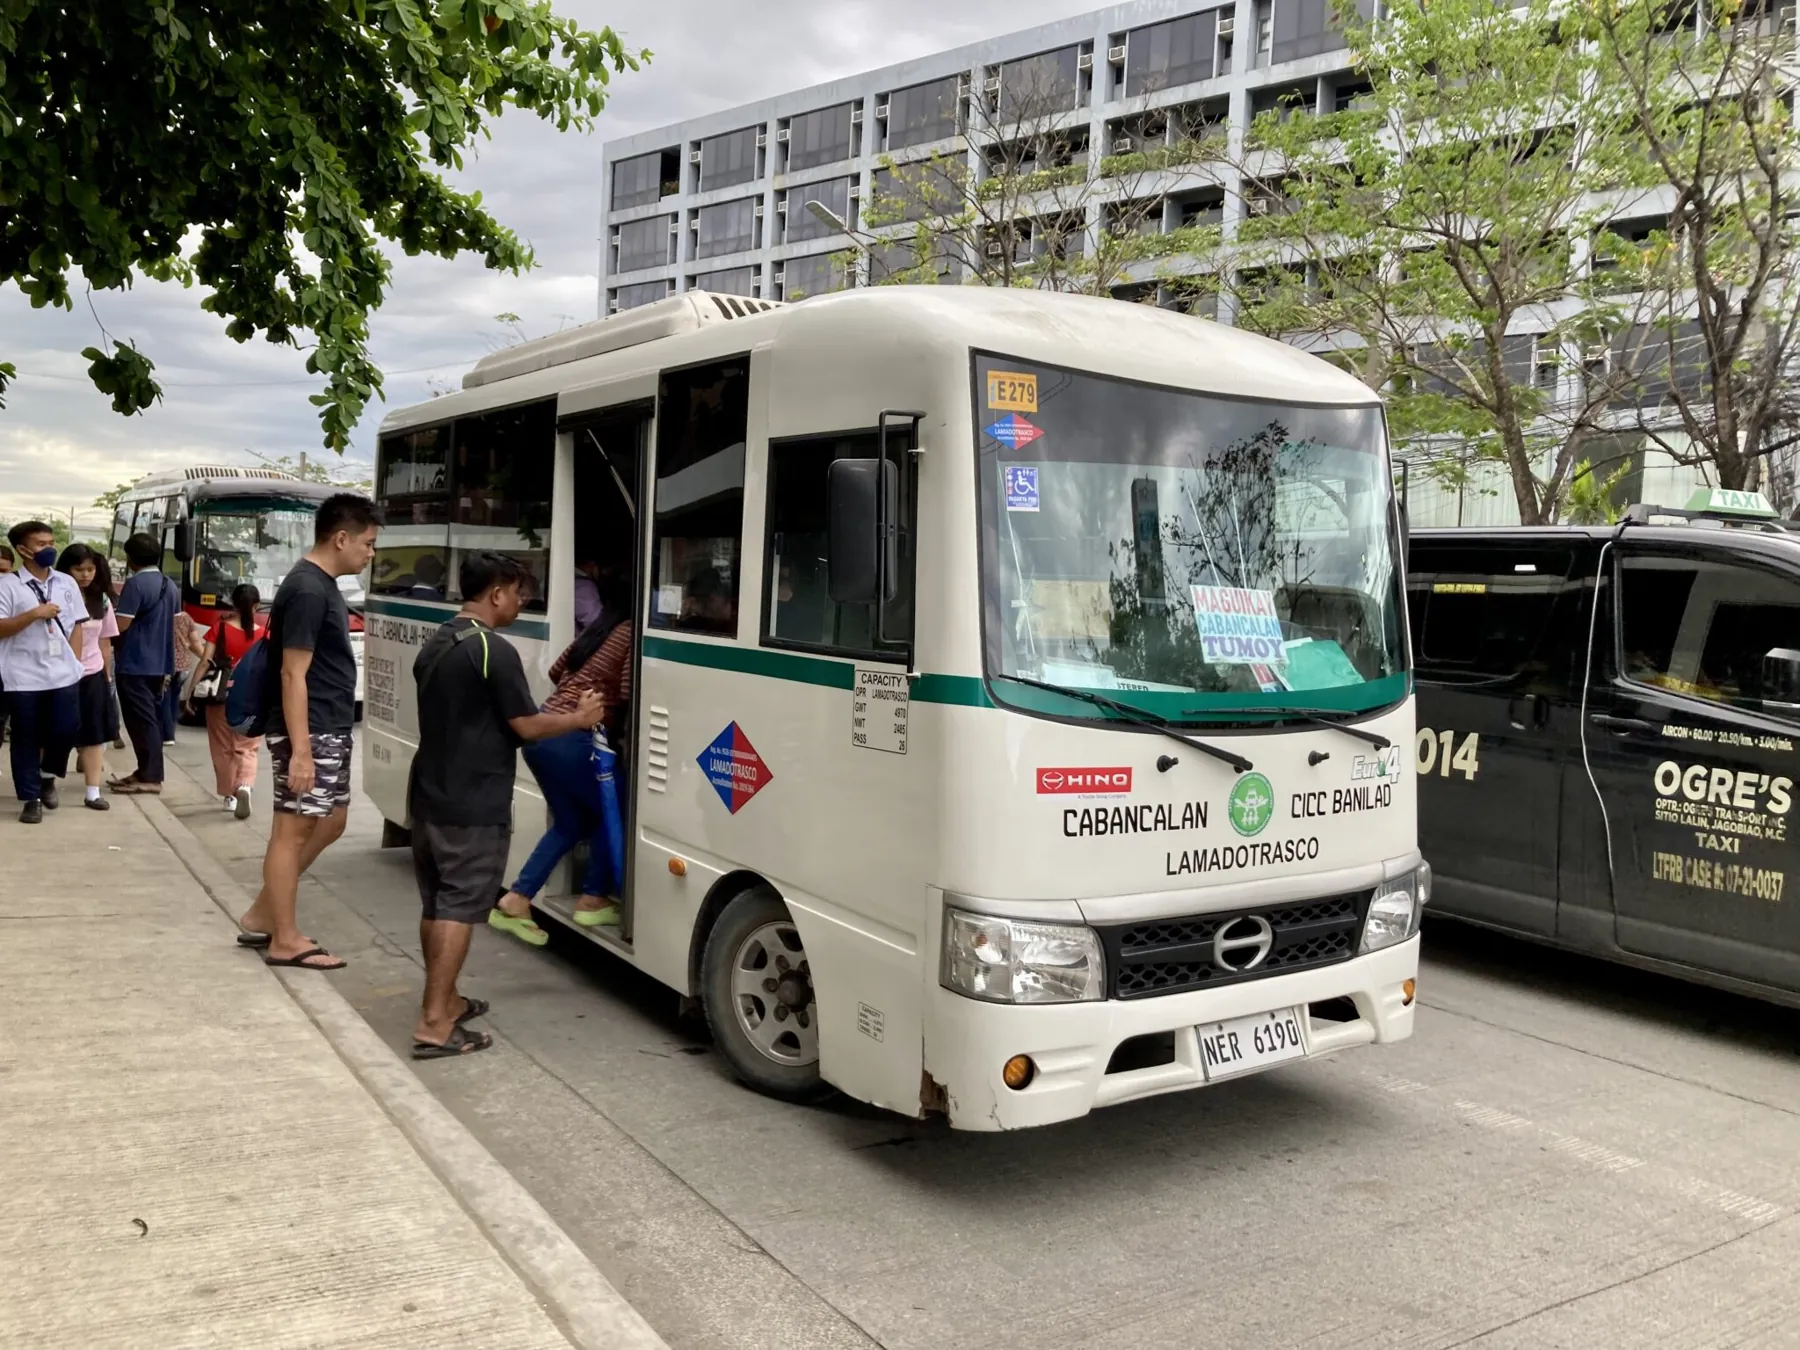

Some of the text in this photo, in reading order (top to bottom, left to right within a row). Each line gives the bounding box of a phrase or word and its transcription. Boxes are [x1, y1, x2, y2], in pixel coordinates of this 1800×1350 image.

[997, 380, 1035, 404] E279
[994, 428, 1034, 437] LAMADOTRASCO
[1717, 491, 1761, 509] TAXI
[1192, 586, 1274, 617] MAGUIKAY
[1197, 613, 1281, 637] CABANCALAN
[1202, 635, 1284, 658] TUMOY
[861, 673, 902, 687] CAPACITY
[855, 686, 908, 703] OPR LAMADOTRASCO
[853, 732, 867, 744] PASS
[1661, 724, 1689, 738] AIRCON
[1693, 728, 1713, 742] 60.00
[709, 757, 757, 782] LAMADOTRASCO
[1067, 773, 1128, 787] HINO
[1654, 760, 1794, 814] OGRE'S
[1290, 792, 1326, 819] CICC
[1331, 783, 1391, 815] BANILAD
[1063, 801, 1208, 837] CABANCALAN
[1655, 810, 1678, 823] SITIO
[1694, 832, 1740, 854] TAXI
[1166, 836, 1319, 876] LAMADOTRASCO
[1652, 851, 1683, 883] LTFRB
[1685, 857, 1712, 889] CASE
[1203, 1019, 1299, 1066] NER 6190
